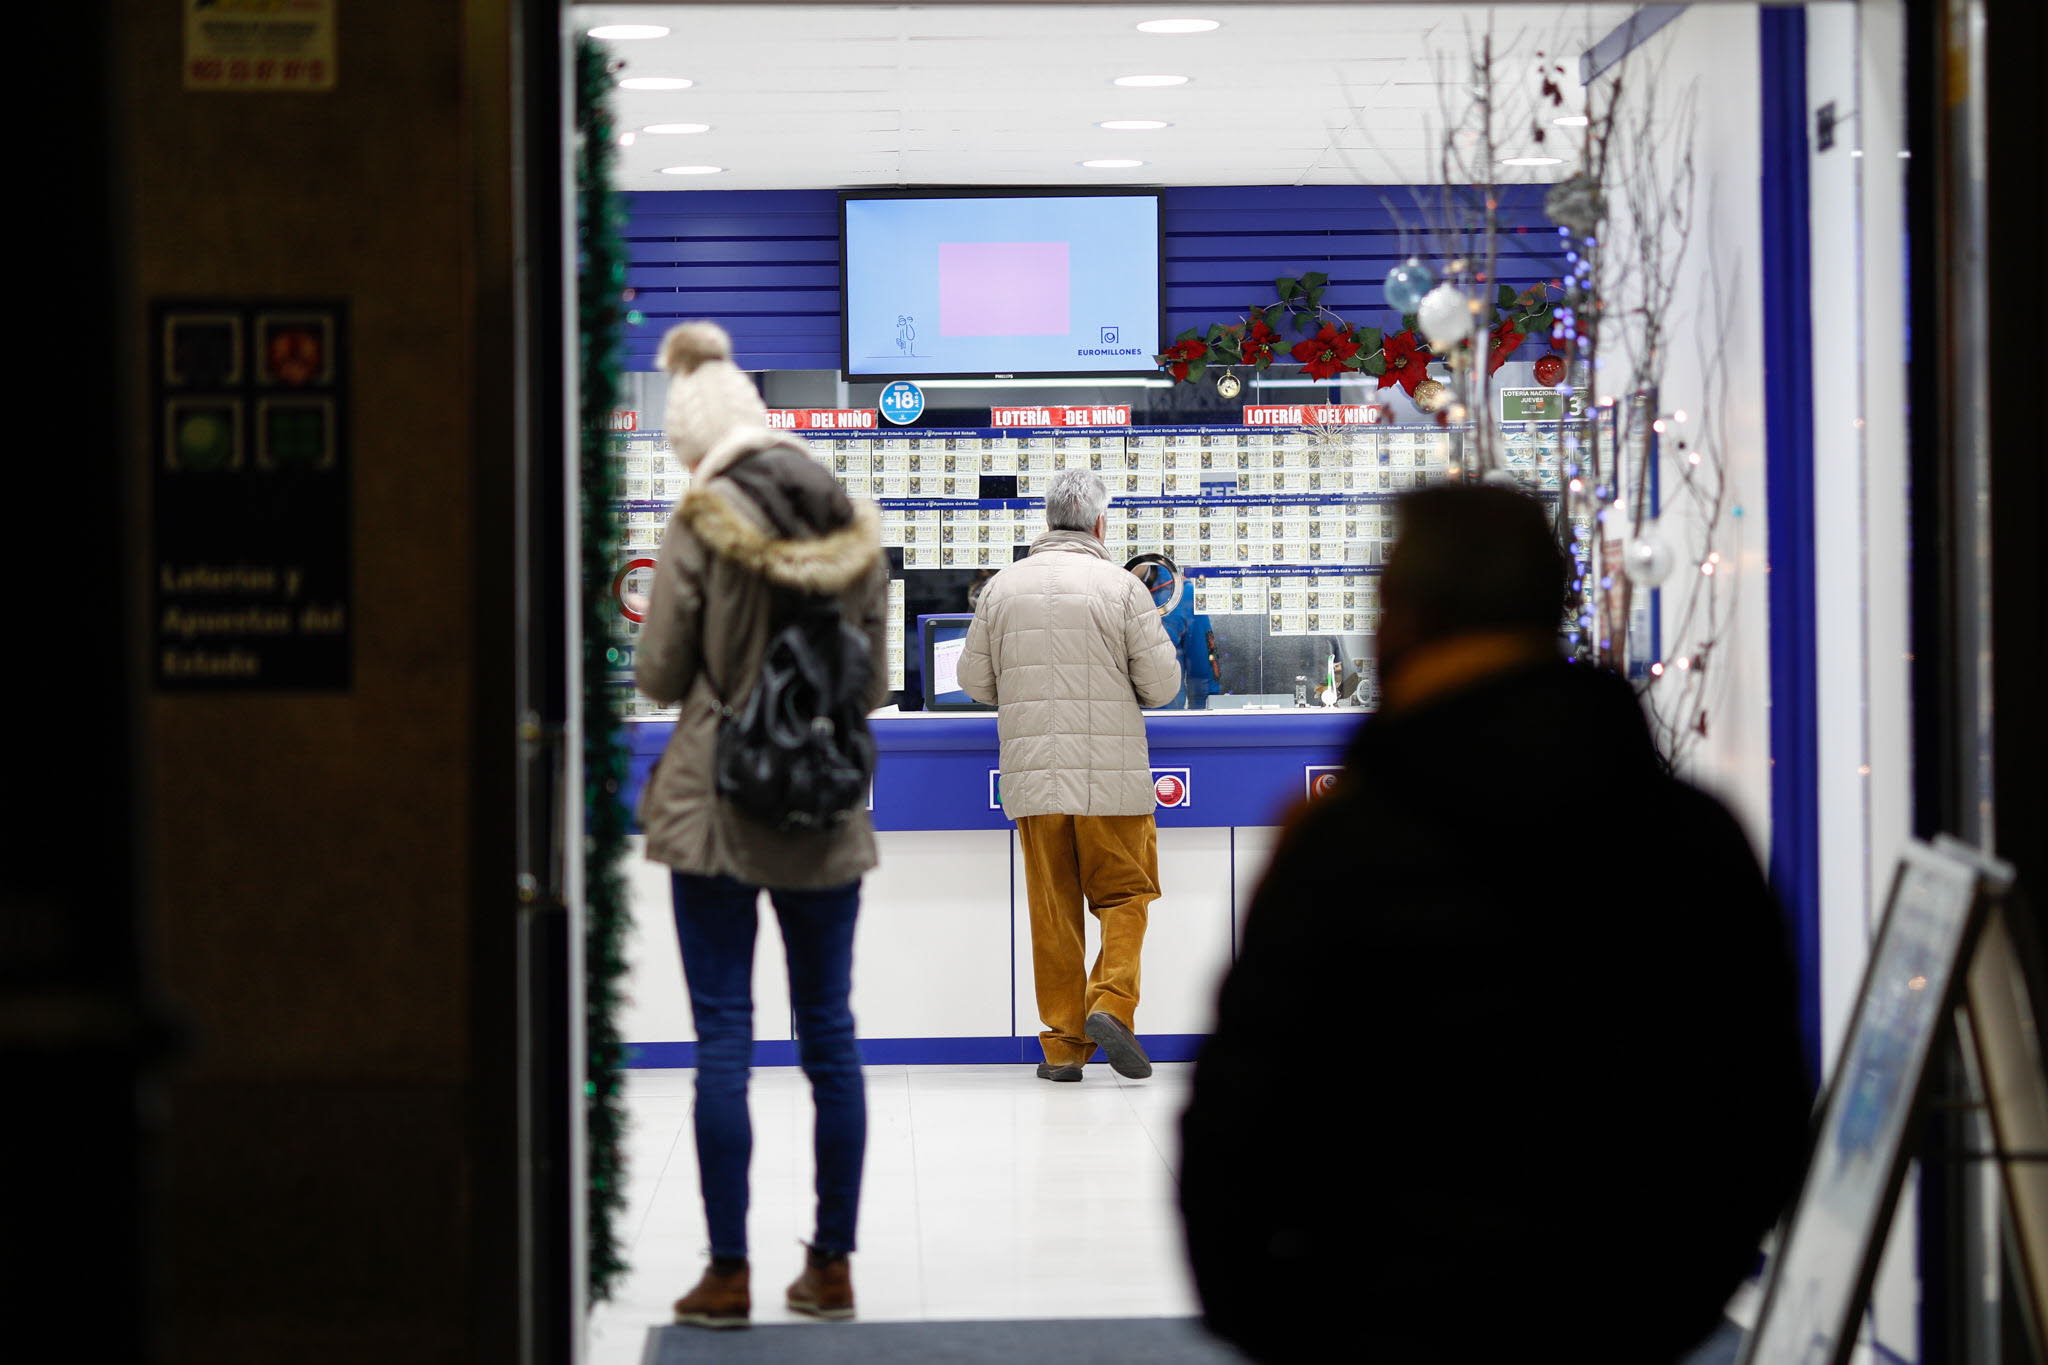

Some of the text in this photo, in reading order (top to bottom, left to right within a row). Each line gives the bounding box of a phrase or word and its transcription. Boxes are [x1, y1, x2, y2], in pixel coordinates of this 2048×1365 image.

[1077, 348, 1142, 356] EUROMILLONES
[886, 391, 914, 409] +18
[811, 412, 836, 428] DEL
[837, 410, 872, 428] NIÑO
[995, 407, 1127, 426] LOTERÍA DEL NIÑO
[1247, 406, 1378, 425] LOTERÍA DEL NIÑO
